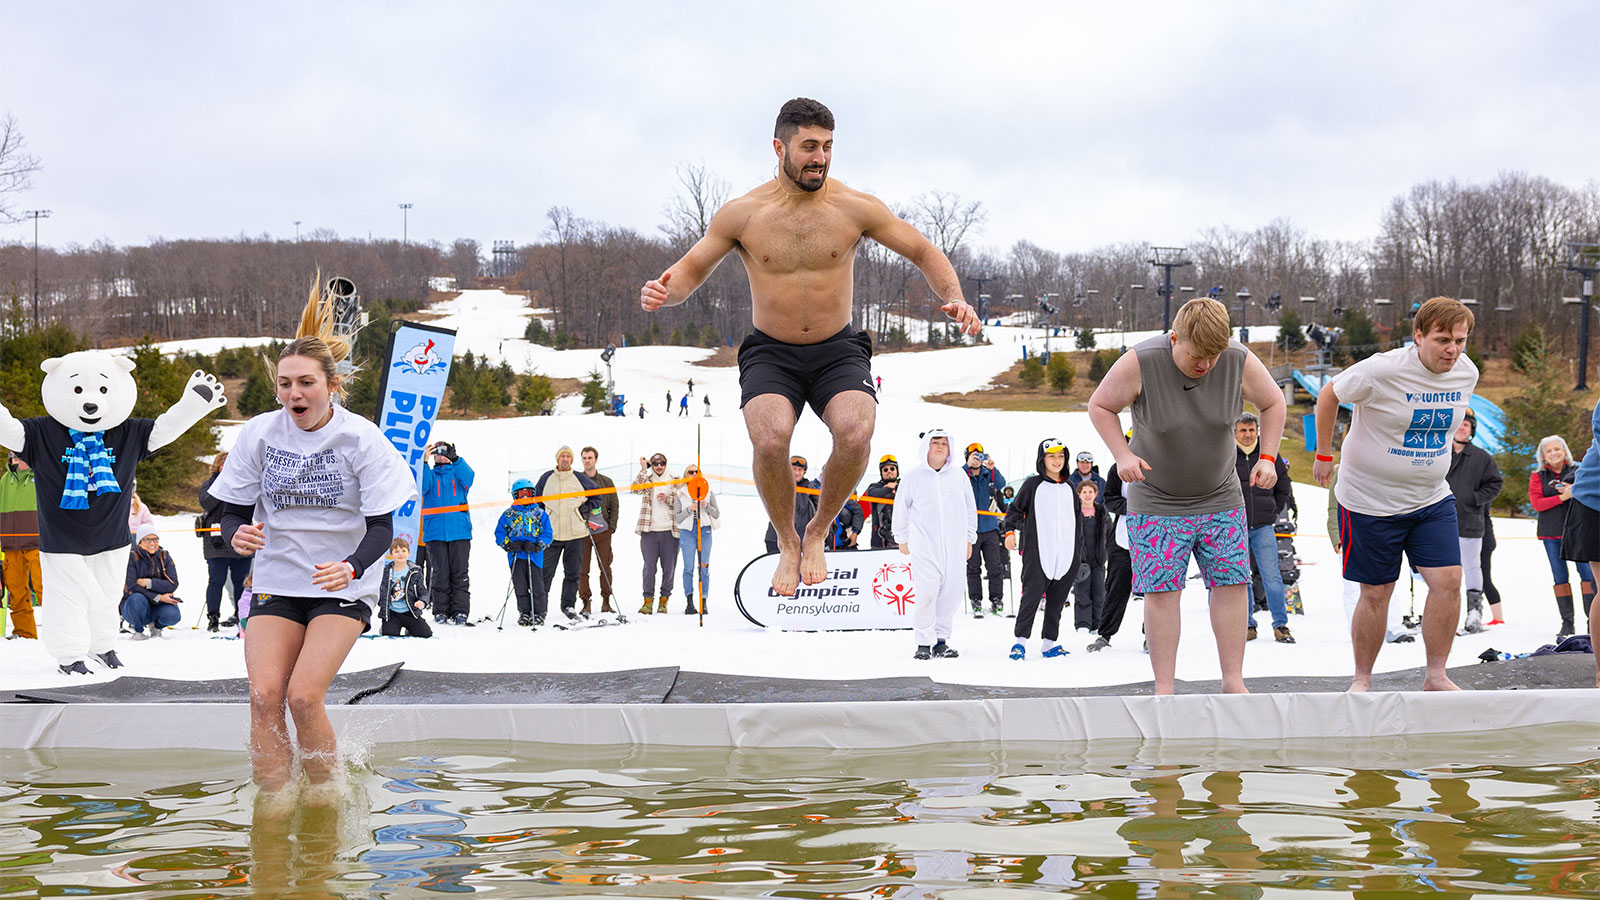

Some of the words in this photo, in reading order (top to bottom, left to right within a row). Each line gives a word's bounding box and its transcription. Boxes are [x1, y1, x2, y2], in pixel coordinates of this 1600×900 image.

[1390, 447, 1415, 457] INDOOR
[266, 452, 302, 468] EPRESENTS
[302, 460, 312, 468] ALL
[316, 456, 324, 464] OF
[326, 454, 338, 464] US.
[306, 464, 326, 472] CULTURE
[298, 473, 342, 484] TEAMMATES
[284, 495, 291, 504] IT
[294, 496, 314, 505] WITH
[768, 585, 860, 600] Oympics
[777, 602, 860, 616] Pennsylvania
